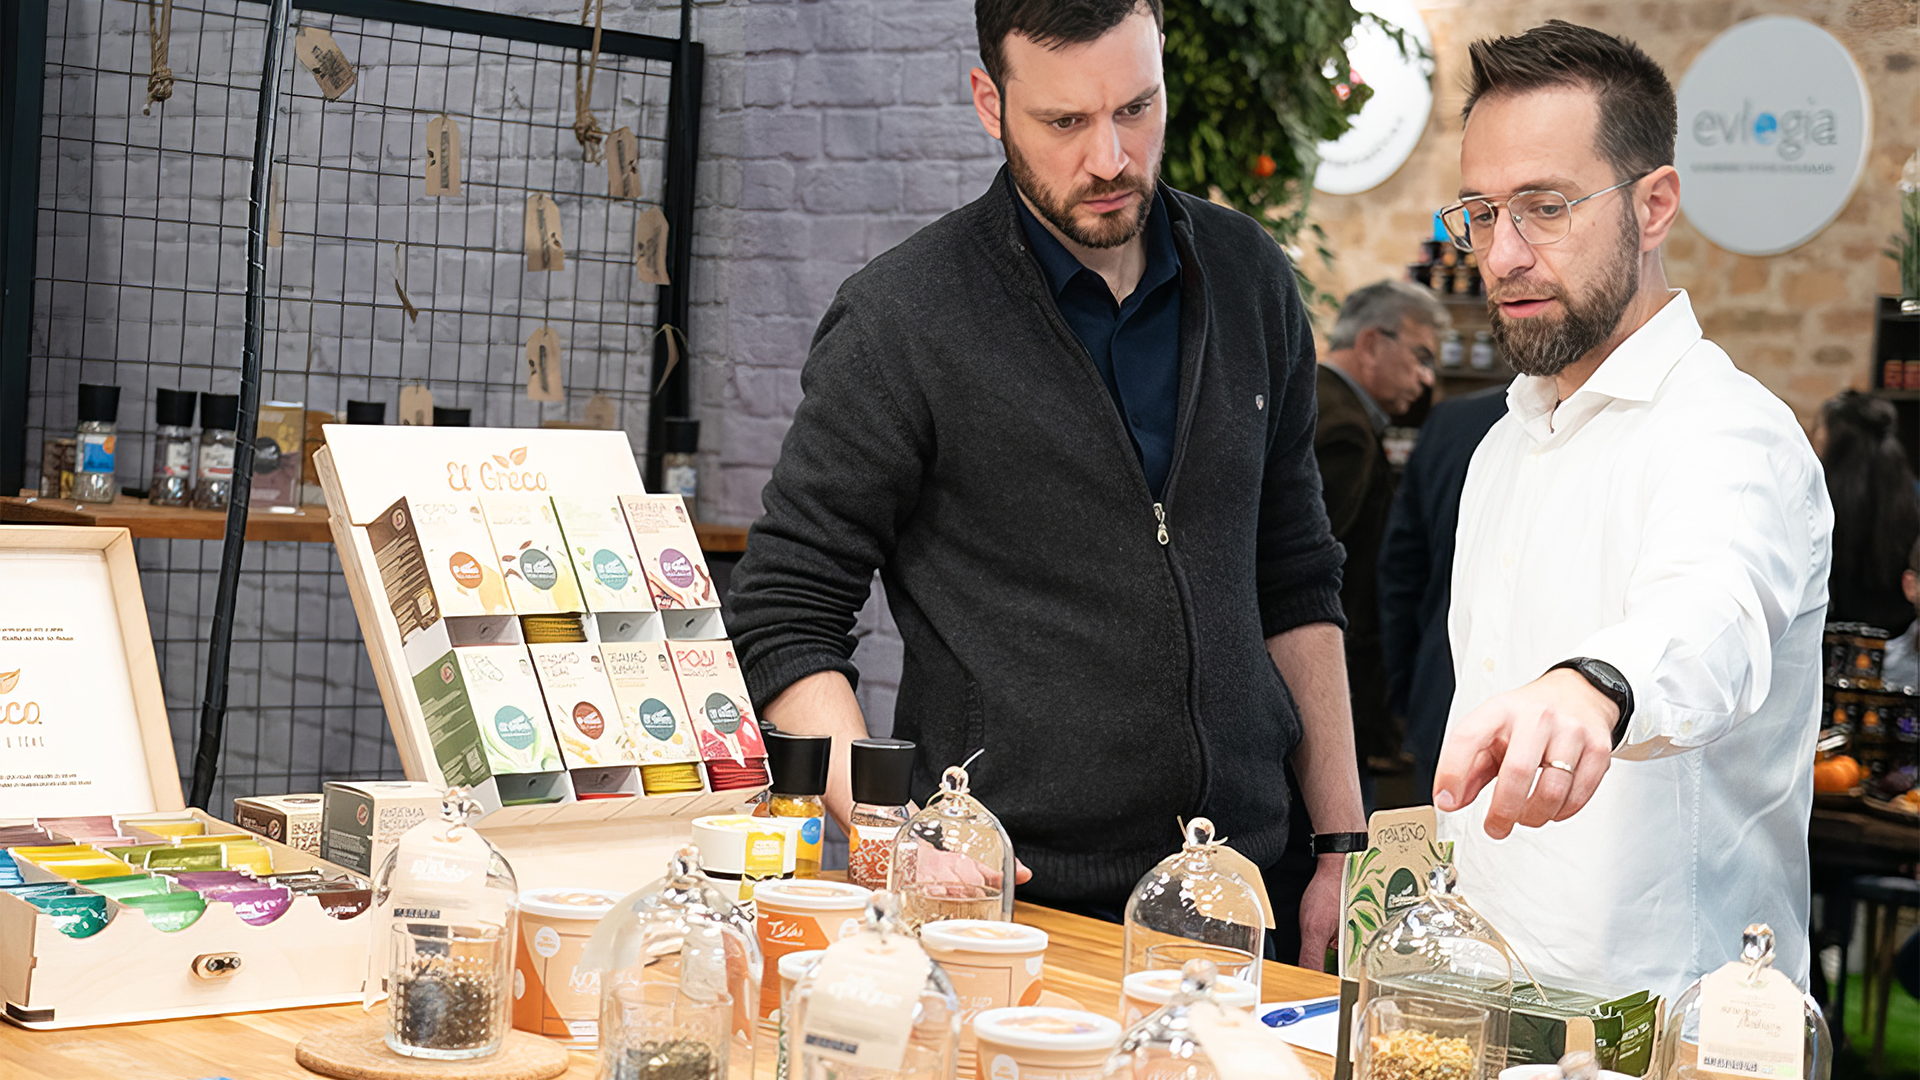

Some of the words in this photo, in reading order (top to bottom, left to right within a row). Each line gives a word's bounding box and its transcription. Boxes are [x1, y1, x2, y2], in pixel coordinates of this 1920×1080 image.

[1692, 97, 1837, 161] evlogia
[446, 461, 472, 491] El
[480, 461, 547, 491] Greco
